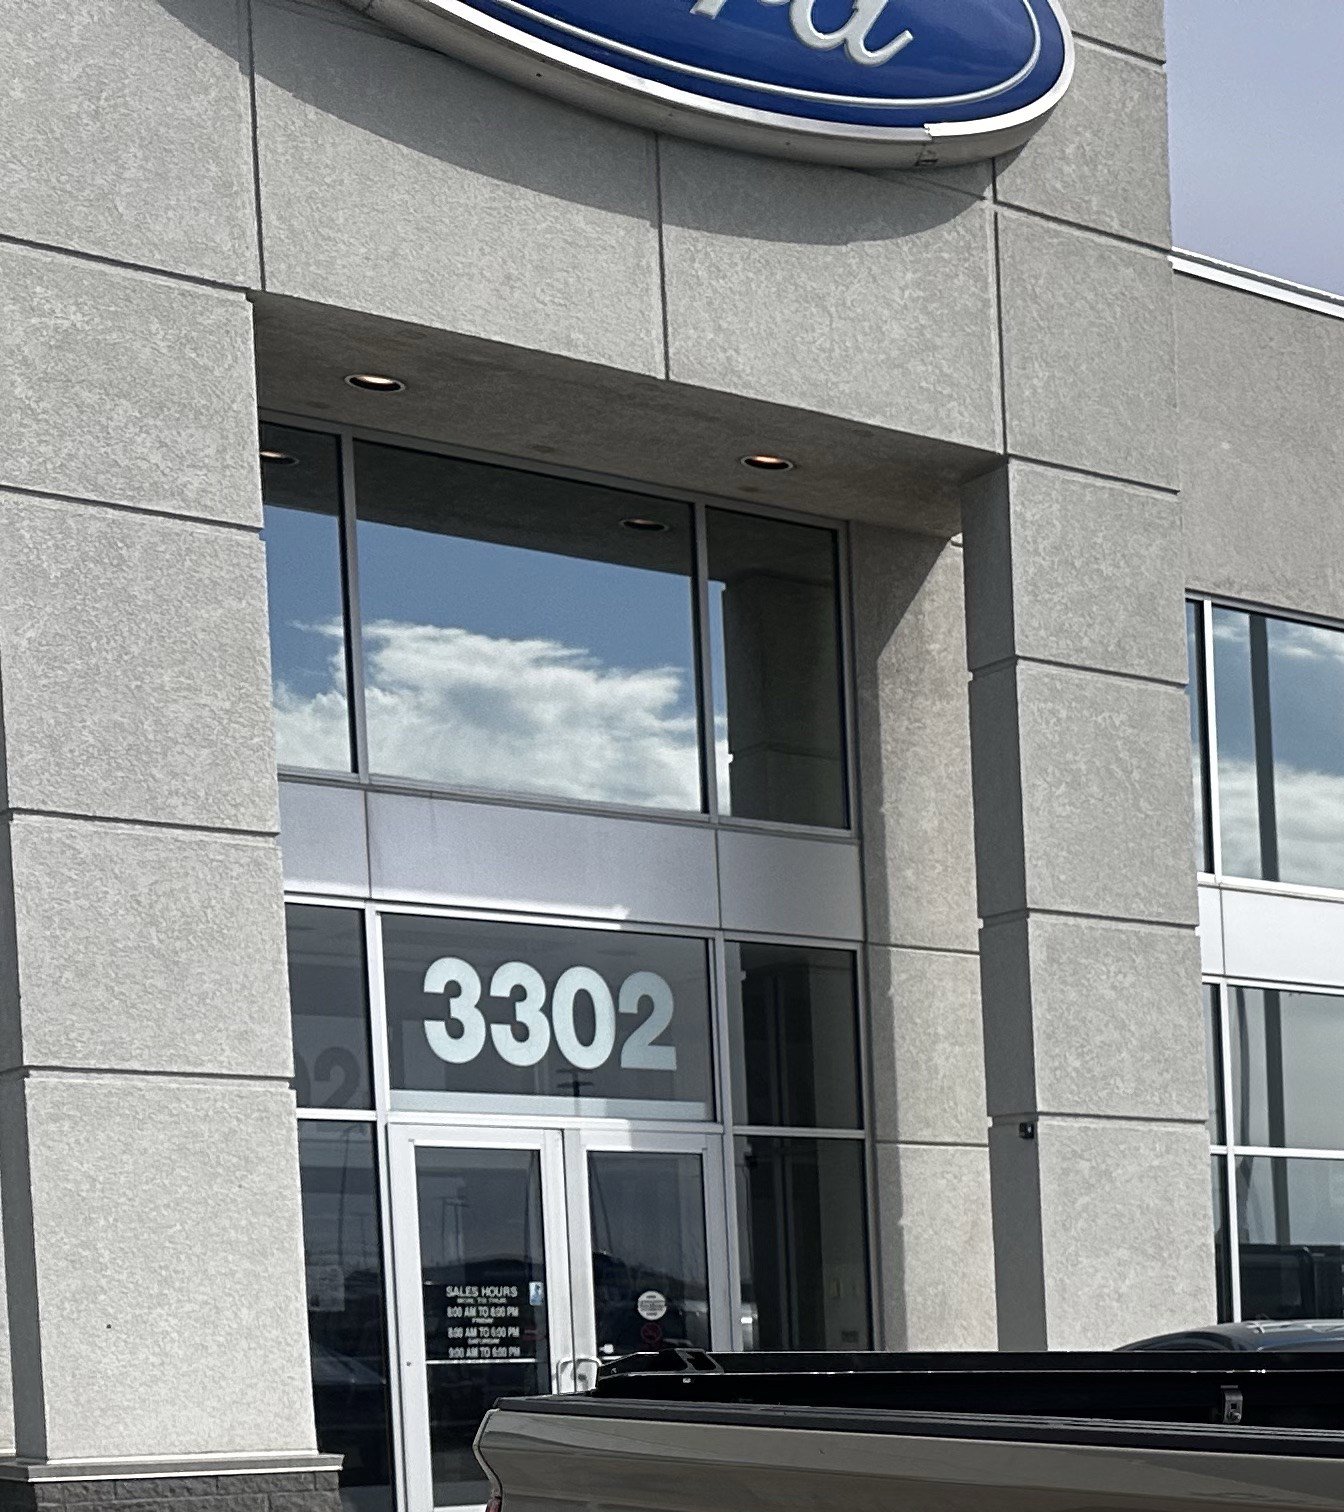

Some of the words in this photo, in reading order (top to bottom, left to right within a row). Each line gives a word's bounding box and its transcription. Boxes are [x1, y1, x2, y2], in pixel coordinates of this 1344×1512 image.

[423, 956, 677, 1070] 3302
[446, 1286, 478, 1297] SALES
[481, 1286, 518, 1297] HOURS
[478, 1306, 489, 1317] TO
[507, 1306, 519, 1317] PM
[479, 1327, 490, 1337] TO
[508, 1326, 519, 1337] PM
[480, 1347, 490, 1357] TO
[508, 1347, 520, 1357] PM
